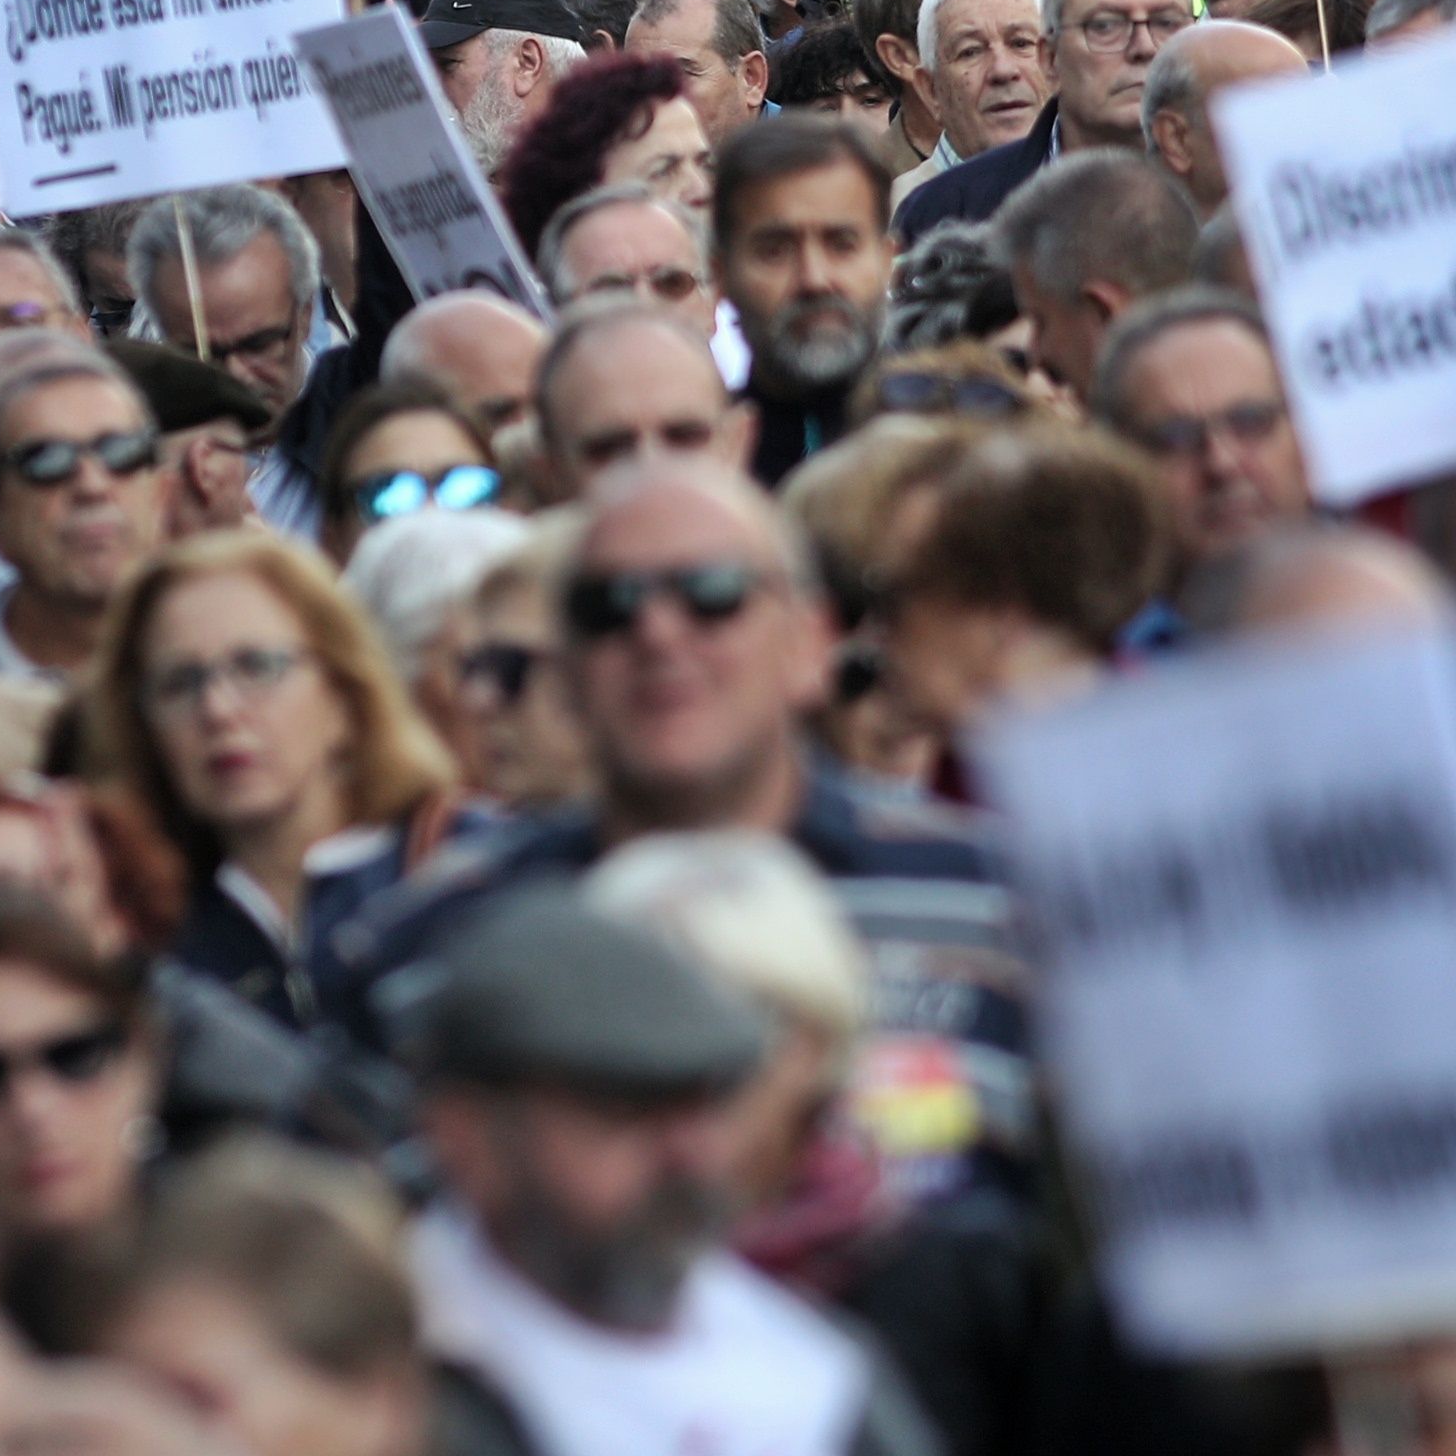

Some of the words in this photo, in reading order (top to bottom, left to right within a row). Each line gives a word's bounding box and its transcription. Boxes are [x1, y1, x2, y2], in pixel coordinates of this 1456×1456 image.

[15, 71, 103, 156] Pagué.
[103, 64, 136, 130] Mi
[139, 49, 238, 141] pensión
